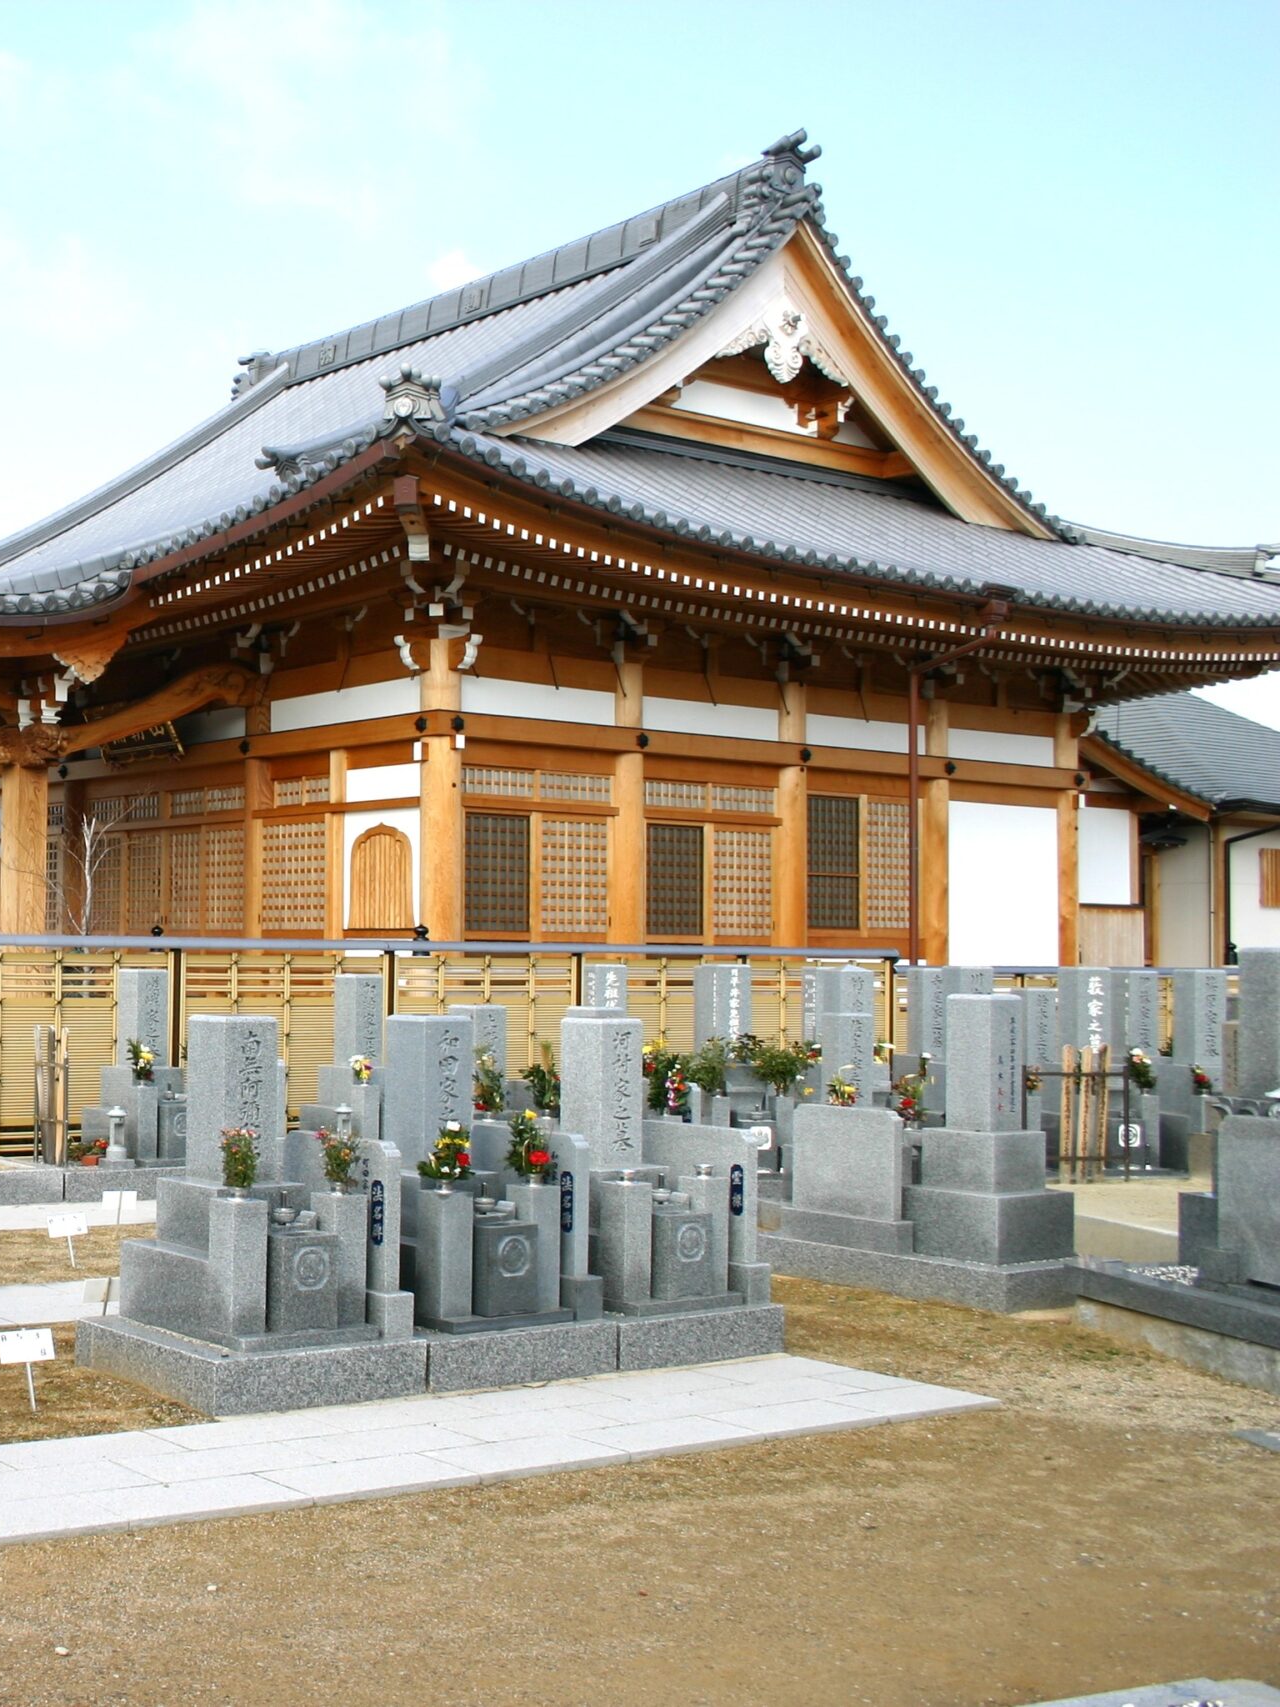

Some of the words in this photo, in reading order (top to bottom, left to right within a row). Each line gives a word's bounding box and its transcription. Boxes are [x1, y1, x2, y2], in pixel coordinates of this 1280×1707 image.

[437, 1029, 461, 1122] 和田家之
[611, 1031, 635, 1152] 河村家之墓
